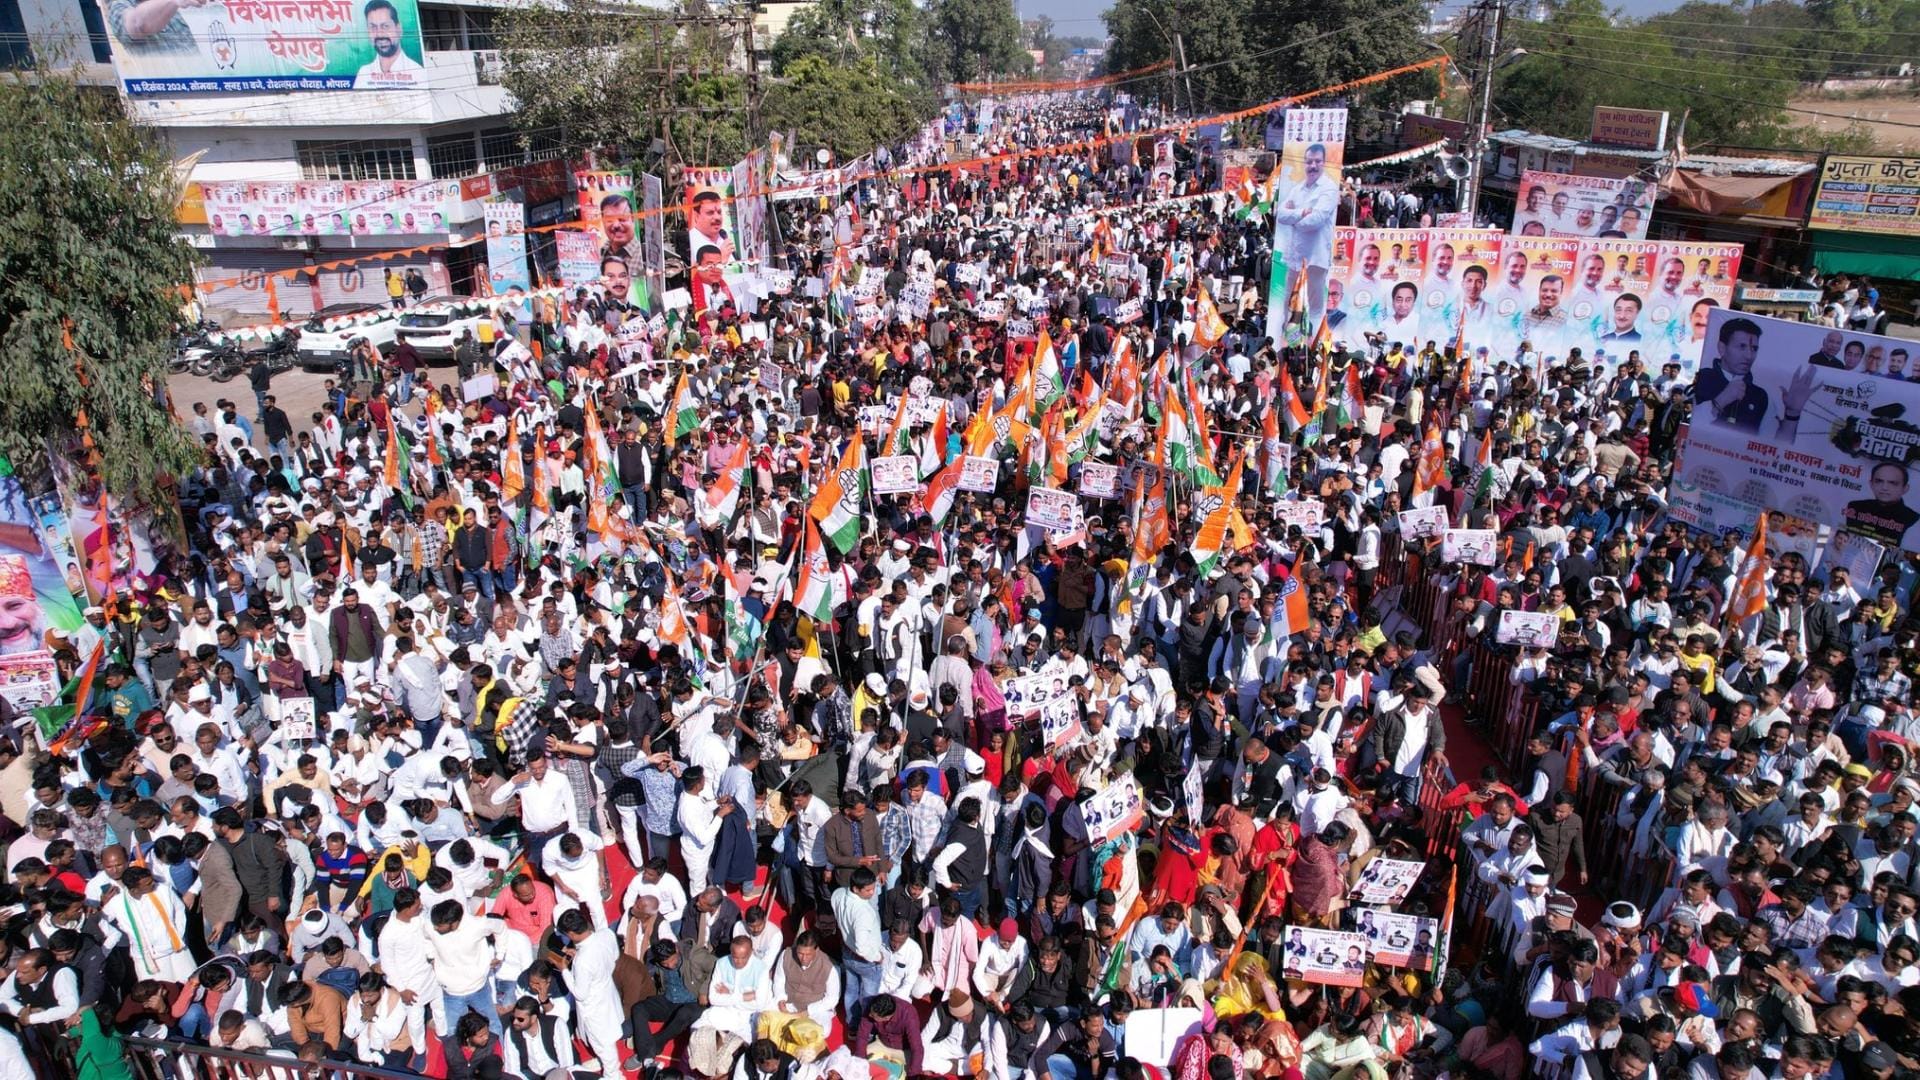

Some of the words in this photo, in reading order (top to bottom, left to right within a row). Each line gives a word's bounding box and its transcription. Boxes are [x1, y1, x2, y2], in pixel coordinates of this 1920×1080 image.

[223, 0, 353, 34] विधानसभा
[266, 30, 326, 69] घेराव
[1827, 162, 1875, 180] गुप्ता
[1856, 420, 1920, 446] विधानसभ
[1860, 436, 1910, 462] घेराव
